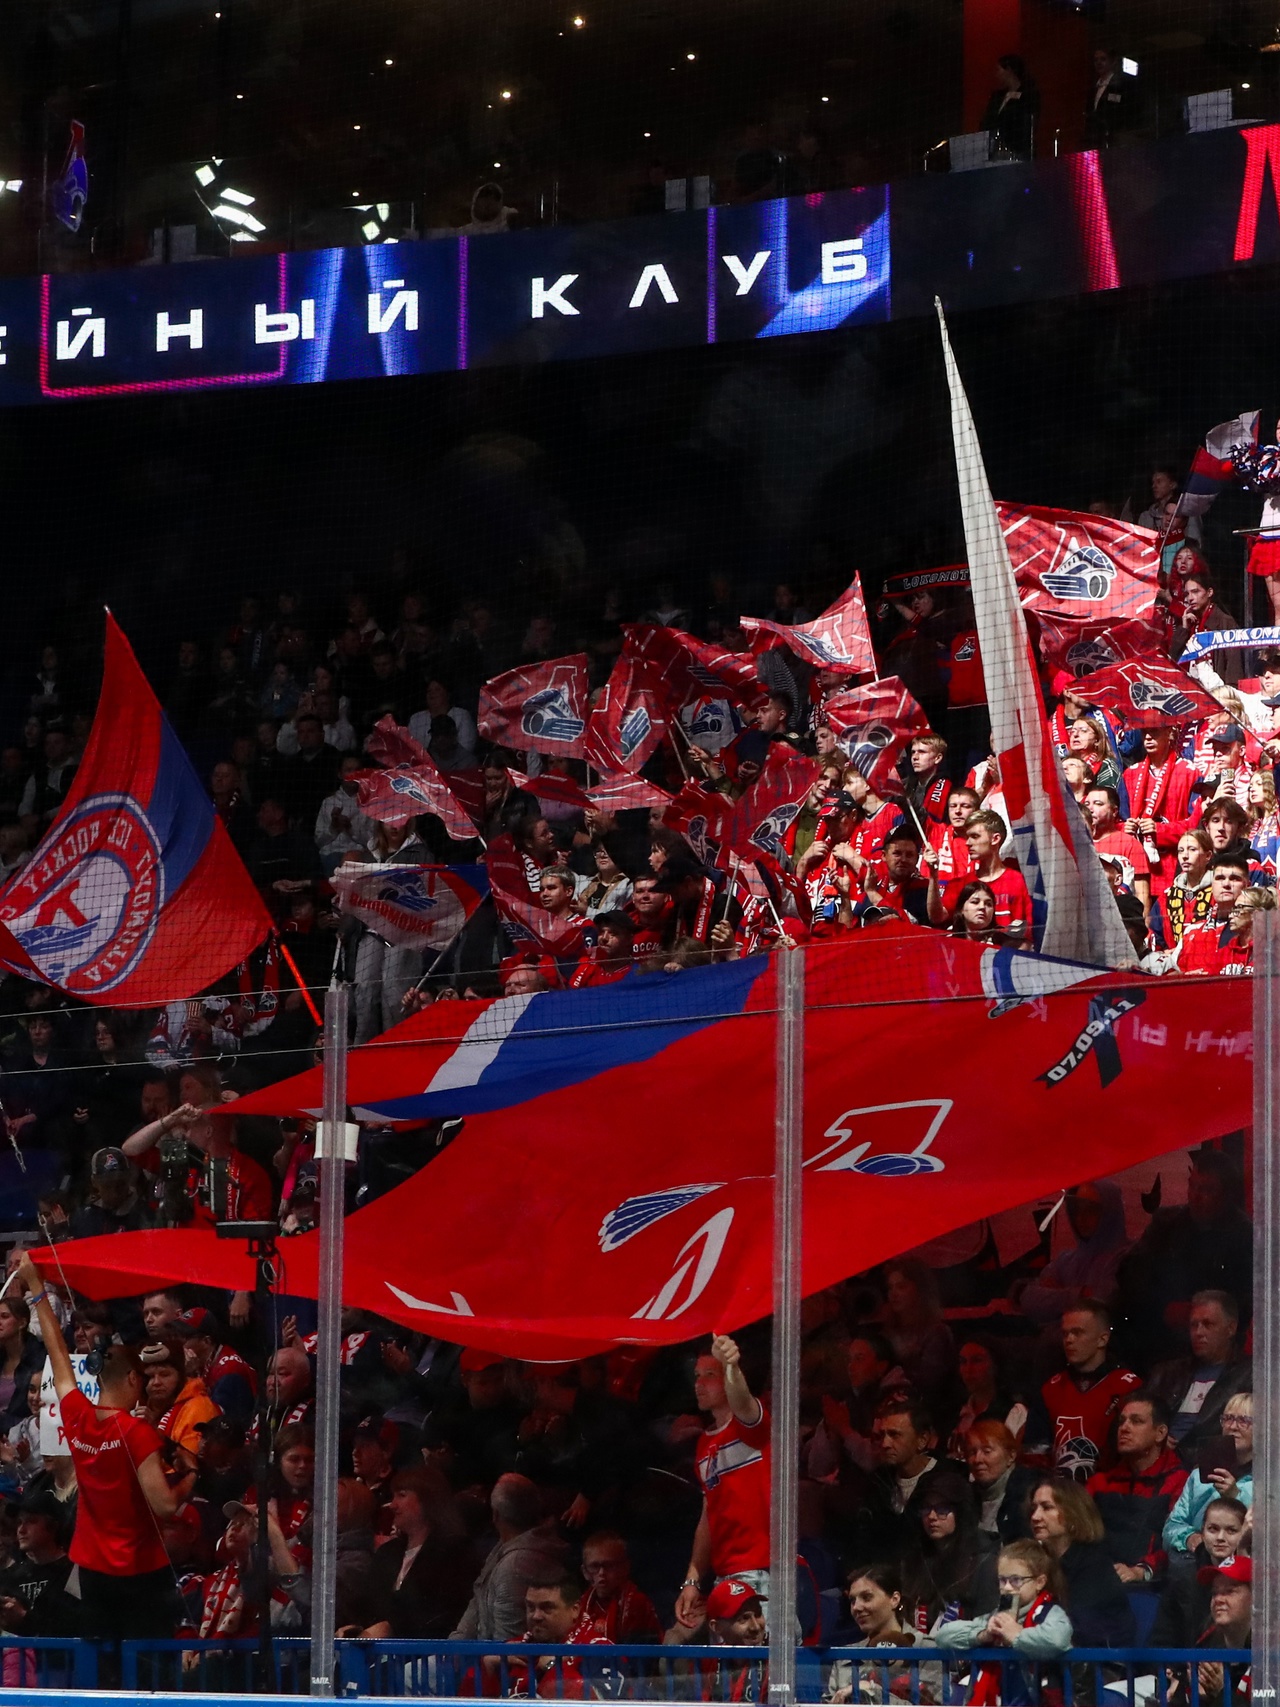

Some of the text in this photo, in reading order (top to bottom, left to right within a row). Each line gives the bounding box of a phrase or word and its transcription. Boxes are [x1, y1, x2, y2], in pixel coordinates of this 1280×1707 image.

[0, 238, 867, 365] ЙНЫЙ КЛУБ
[903, 568, 968, 590] LOKOMOT
[1046, 999, 1136, 1084] 07.09.11
[42, 1376, 54, 1391] #1
[1252, 1689, 1276, 1698] RAITA
